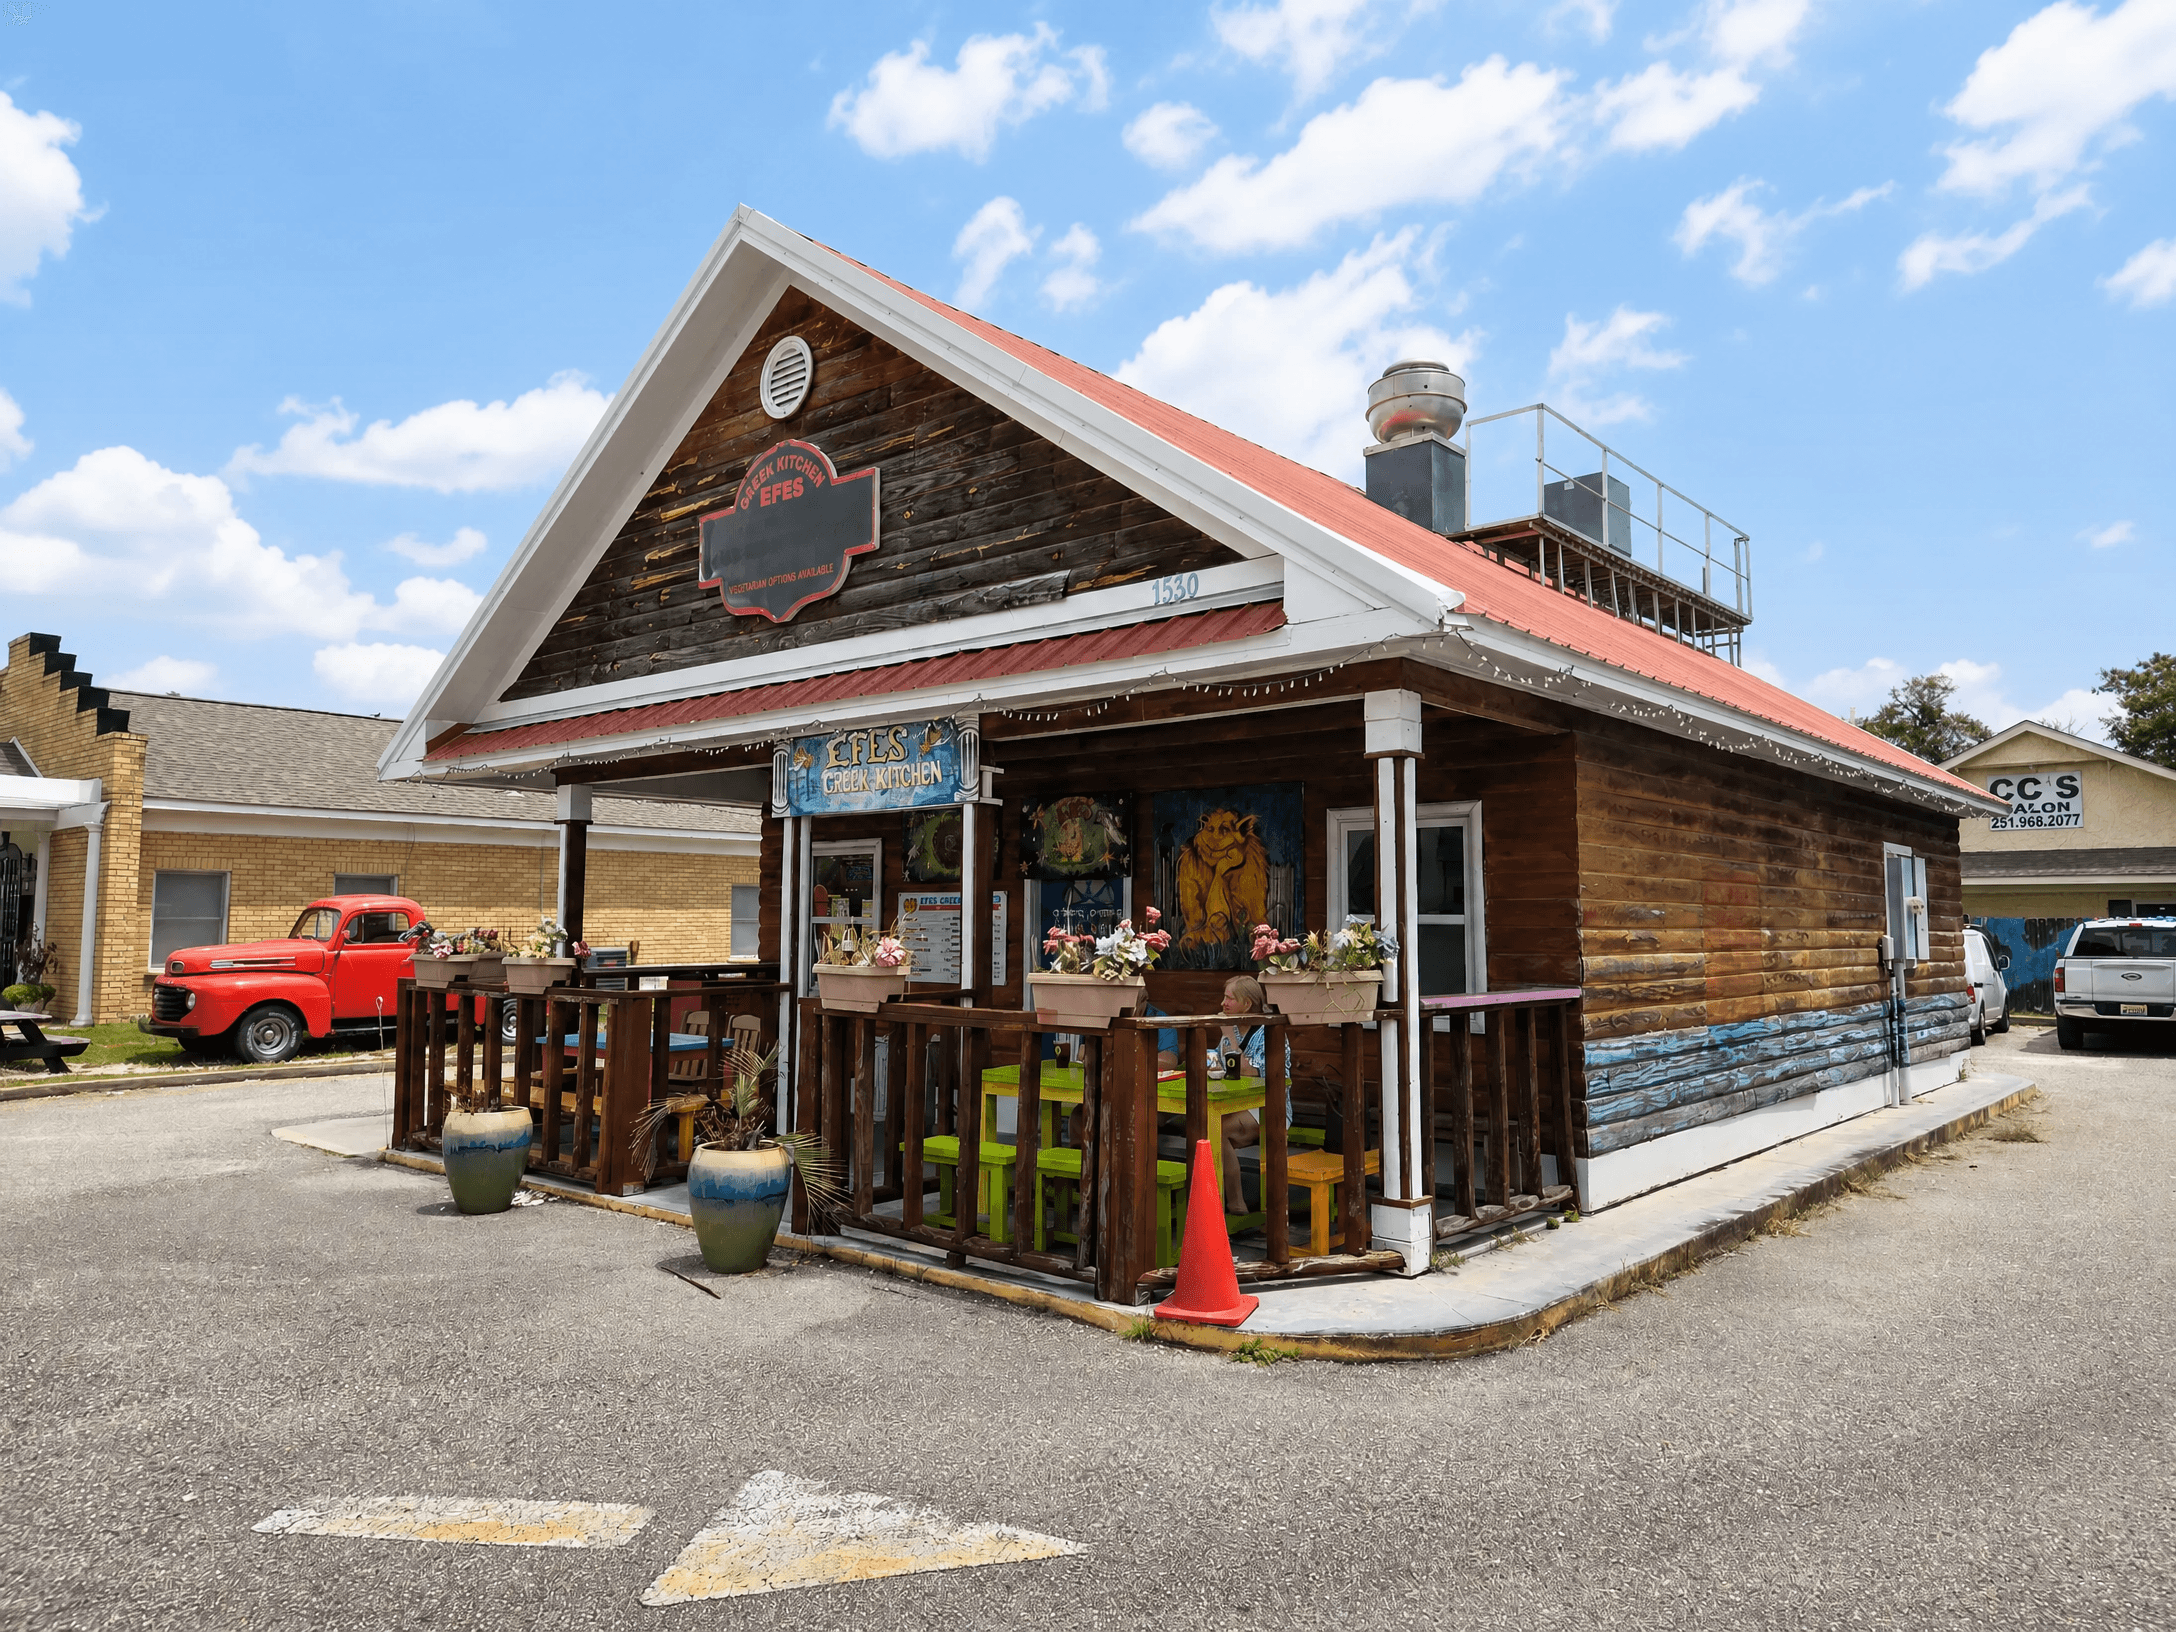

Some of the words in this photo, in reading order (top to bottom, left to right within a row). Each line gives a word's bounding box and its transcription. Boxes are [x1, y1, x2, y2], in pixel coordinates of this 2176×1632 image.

[740, 461, 775, 510] GREEK
[776, 455, 826, 489] KITCHEN
[760, 477, 805, 508] EFES
[768, 571, 797, 587] OPTIONS
[797, 562, 834, 580] AVAILABLE
[1151, 573, 1199, 605] 1530
[825, 725, 909, 769] EFES
[874, 760, 943, 791] KITCHEN
[1991, 813, 2081, 829] 251.968.2077
[2012, 802, 2070, 815] ALON
